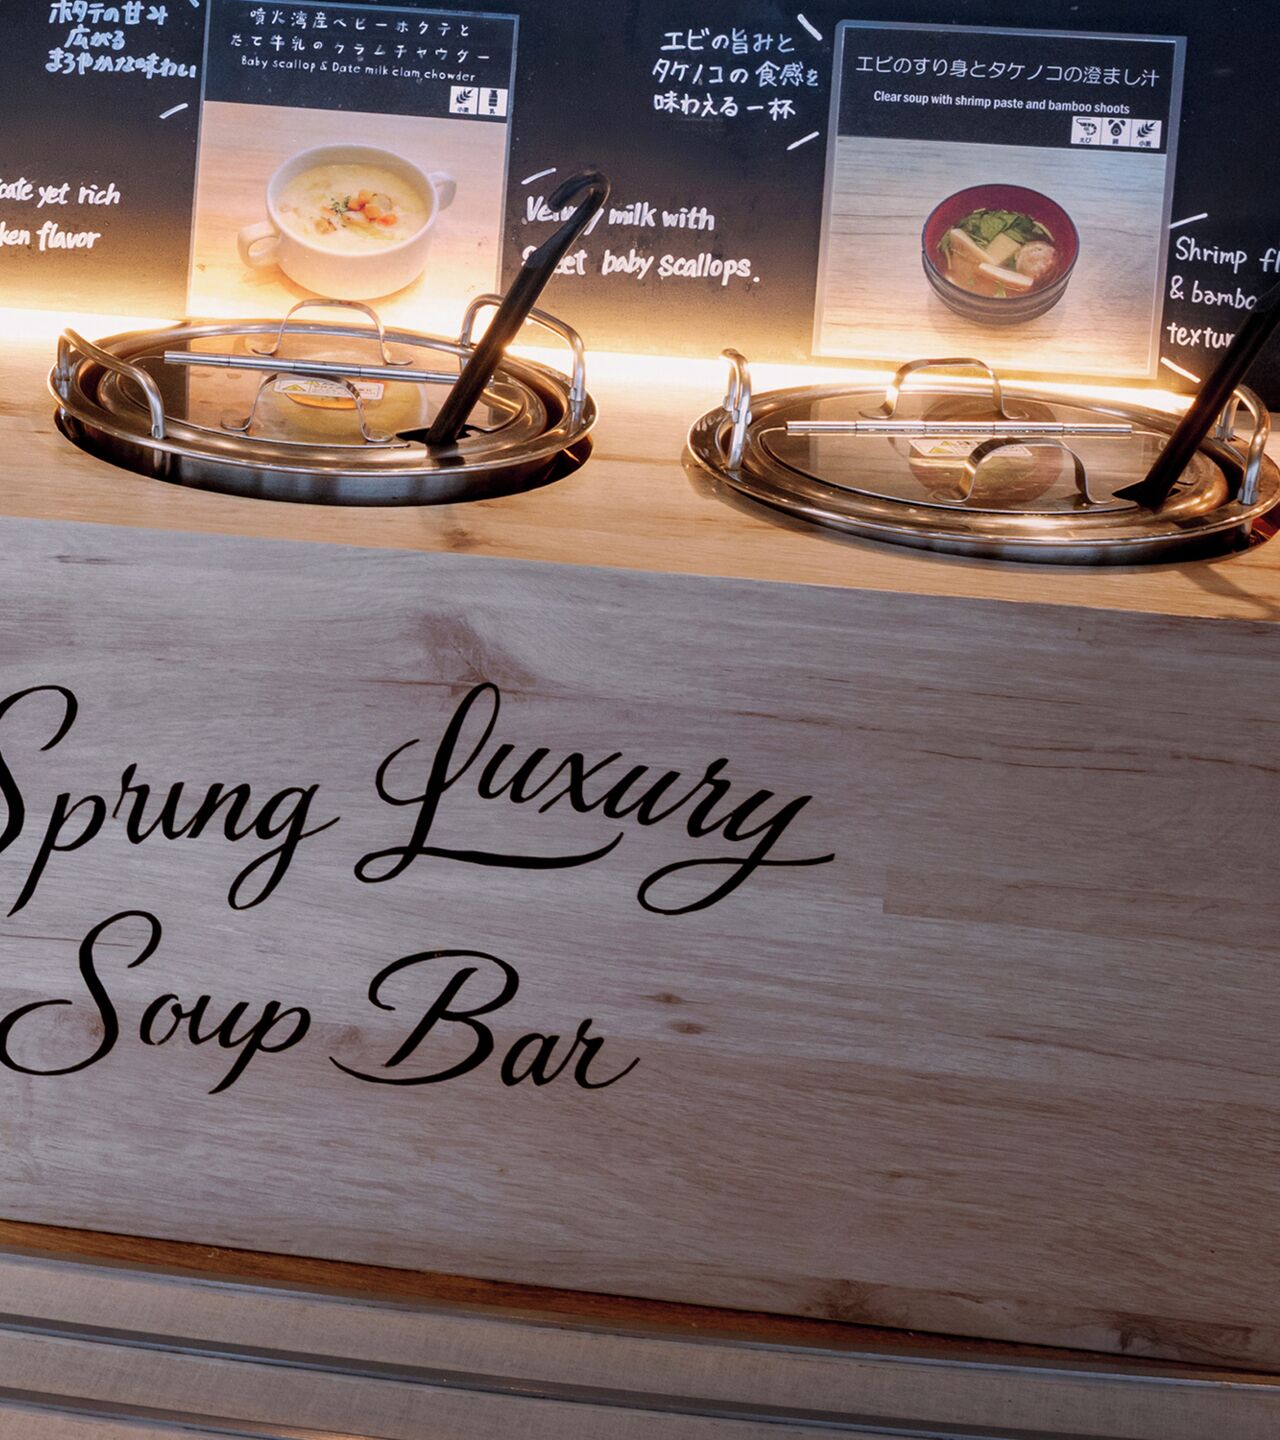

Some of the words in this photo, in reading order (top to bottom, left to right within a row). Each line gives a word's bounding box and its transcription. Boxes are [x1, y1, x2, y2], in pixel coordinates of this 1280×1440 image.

[64, 24, 126, 50] 広がる
[660, 27, 795, 55] エビの旨みと
[45, 47, 197, 79] まろやかな味わい
[241, 55, 268, 69] Baby
[272, 57, 315, 73] scallop
[332, 62, 361, 74] Date
[365, 63, 389, 76] milk
[392, 65, 420, 78] clam
[424, 67, 476, 82] chowder
[652, 57, 819, 88] タケノコの食感を
[856, 55, 1160, 88] エビのすり身とタケノコの澄まし汁
[653, 90, 796, 122] 味わえる一杯
[874, 90, 902, 103] Clear
[903, 93, 929, 106] soup
[931, 93, 954, 106] with
[955, 95, 991, 109] shrimp
[994, 98, 1024, 111] paste
[1026, 99, 1047, 110] and
[1048, 99, 1092, 113] bamboo
[1094, 101, 1130, 115] shoots
[37, 182, 70, 208] yet
[78, 182, 121, 206] rich
[608, 202, 657, 228] milk
[662, 206, 715, 231] with
[37, 221, 102, 251] flavor
[601, 249, 654, 280] baby
[1175, 235, 1248, 274] Shrimp
[1169, 275, 1185, 300] &
[1191, 280, 1258, 310] bambo
[1166, 322, 1236, 349] textur
[354, 680, 836, 917] Luxury
[329, 948, 641, 1090] Bar
